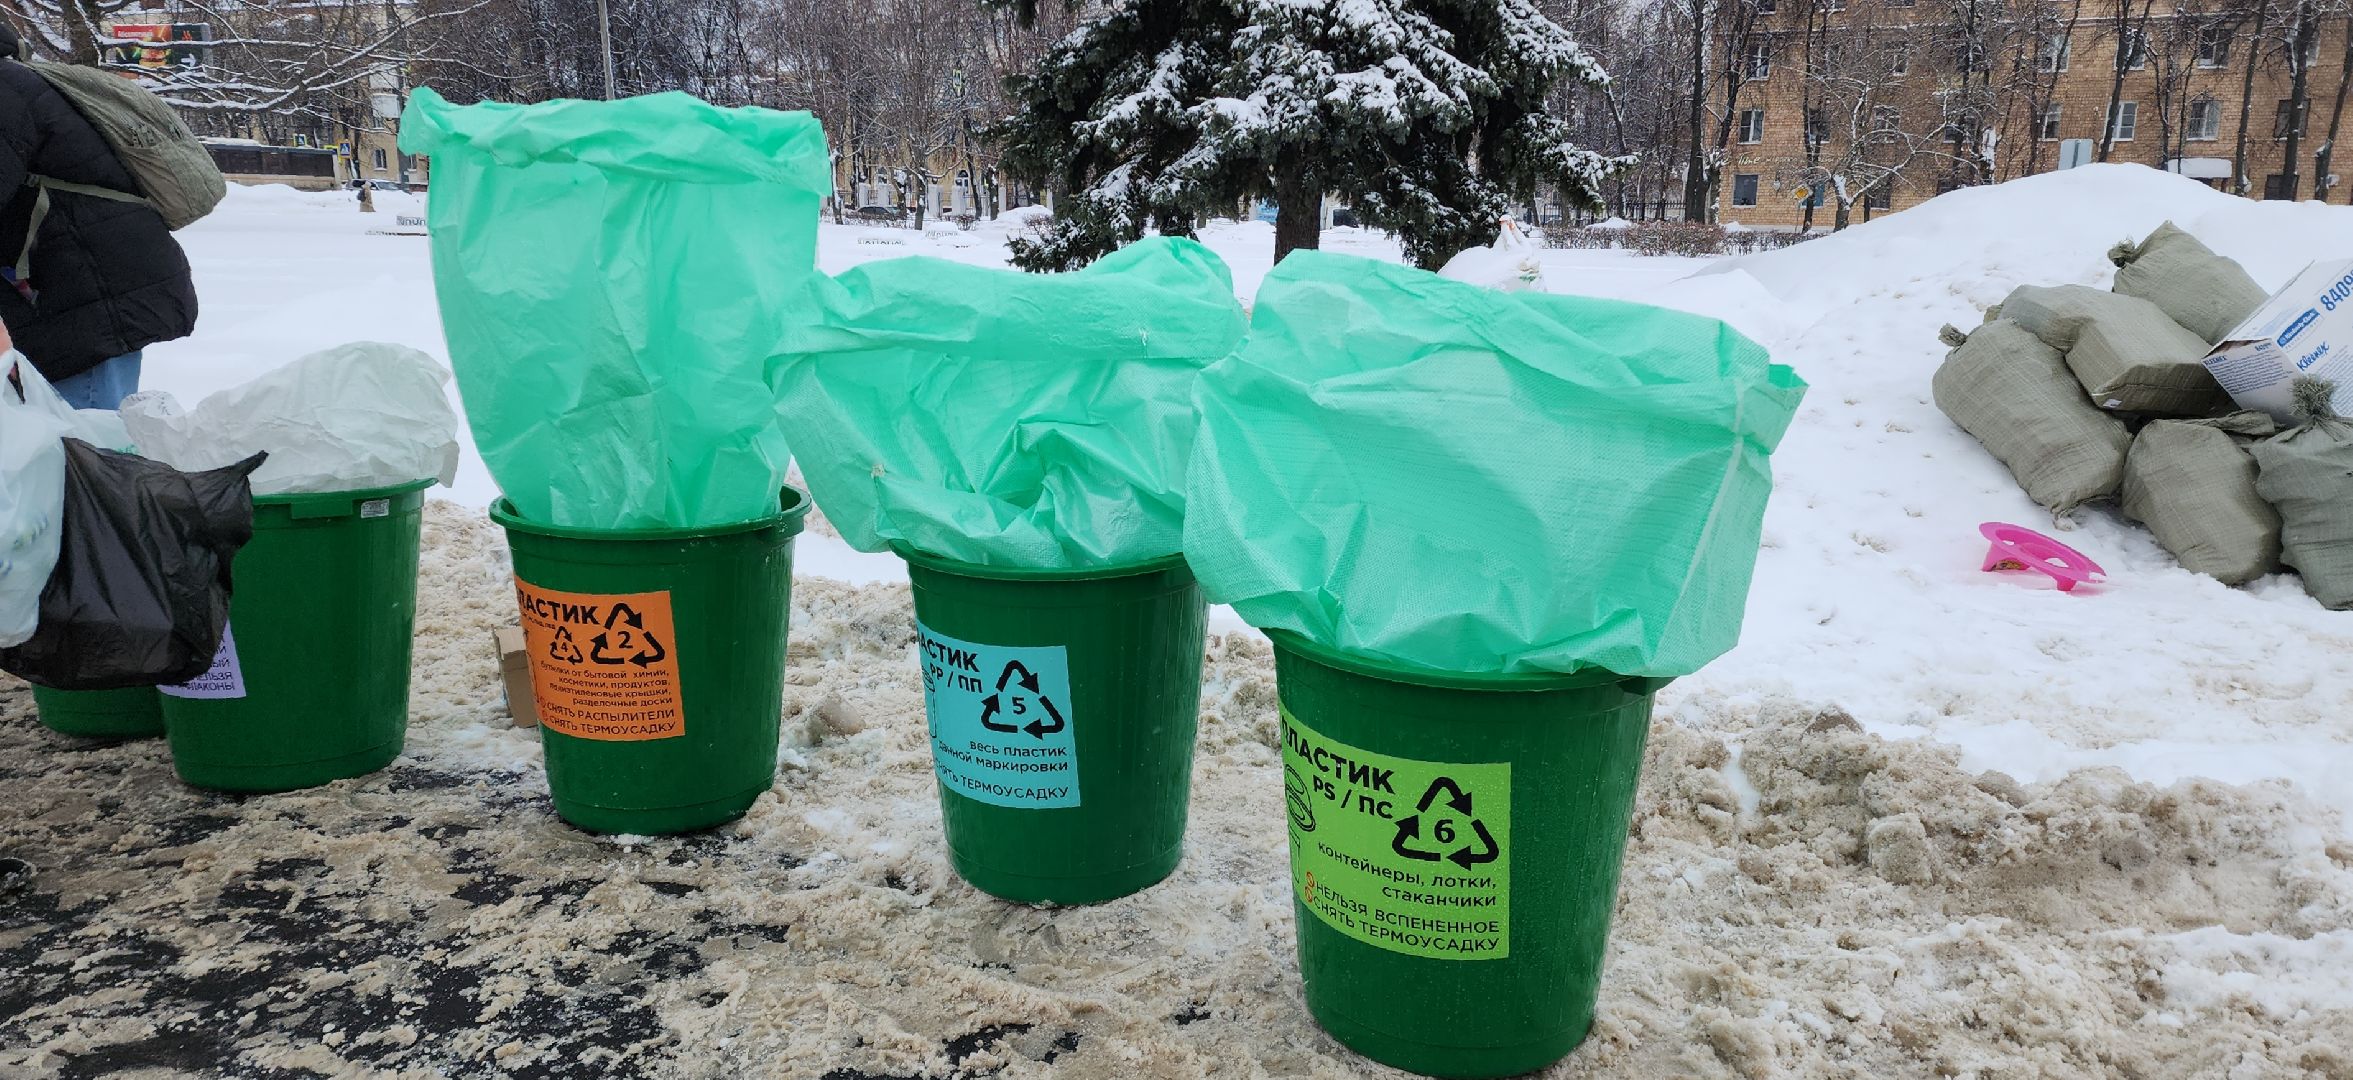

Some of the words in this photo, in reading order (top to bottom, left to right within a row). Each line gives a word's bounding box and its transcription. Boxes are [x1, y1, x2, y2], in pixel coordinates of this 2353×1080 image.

[560, 641, 569, 653] 4
[617, 630, 634, 649] 2
[558, 677, 609, 689] косметики,
[583, 669, 627, 679] бытовой
[633, 669, 670, 679] химии,
[957, 674, 983, 694] ПП
[572, 698, 637, 708] разделочные
[640, 697, 673, 707] доски
[624, 689, 671, 699] крышки,
[547, 702, 576, 718] СНЯТЬ
[577, 708, 675, 722] РАСПЫЛИТЕЛИ
[1011, 696, 1027, 715] 5
[549, 716, 578, 731] СНЯТЬ
[581, 721, 676, 735] ТЕРМОУСАДКУ
[969, 740, 1000, 755] весь
[1003, 746, 1068, 758] пластик
[1281, 714, 1396, 795] ПЛАСТИК
[975, 756, 1068, 774] маркировки
[960, 774, 1069, 801] ТЕРМОУСАДКУ
[1433, 818, 1456, 844] 6
[1318, 841, 1425, 887] контейнеры,
[1431, 876, 1497, 890] лотки,
[1381, 886, 1497, 908] стаканчики
[1316, 881, 1368, 917] НЕЛЬЗЯ
[1375, 908, 1500, 934] ВСПЕНЕННОЕ
[1313, 895, 1355, 929] СНЯТЬ
[1358, 920, 1500, 954] ТЕРМОУСАДКУ
